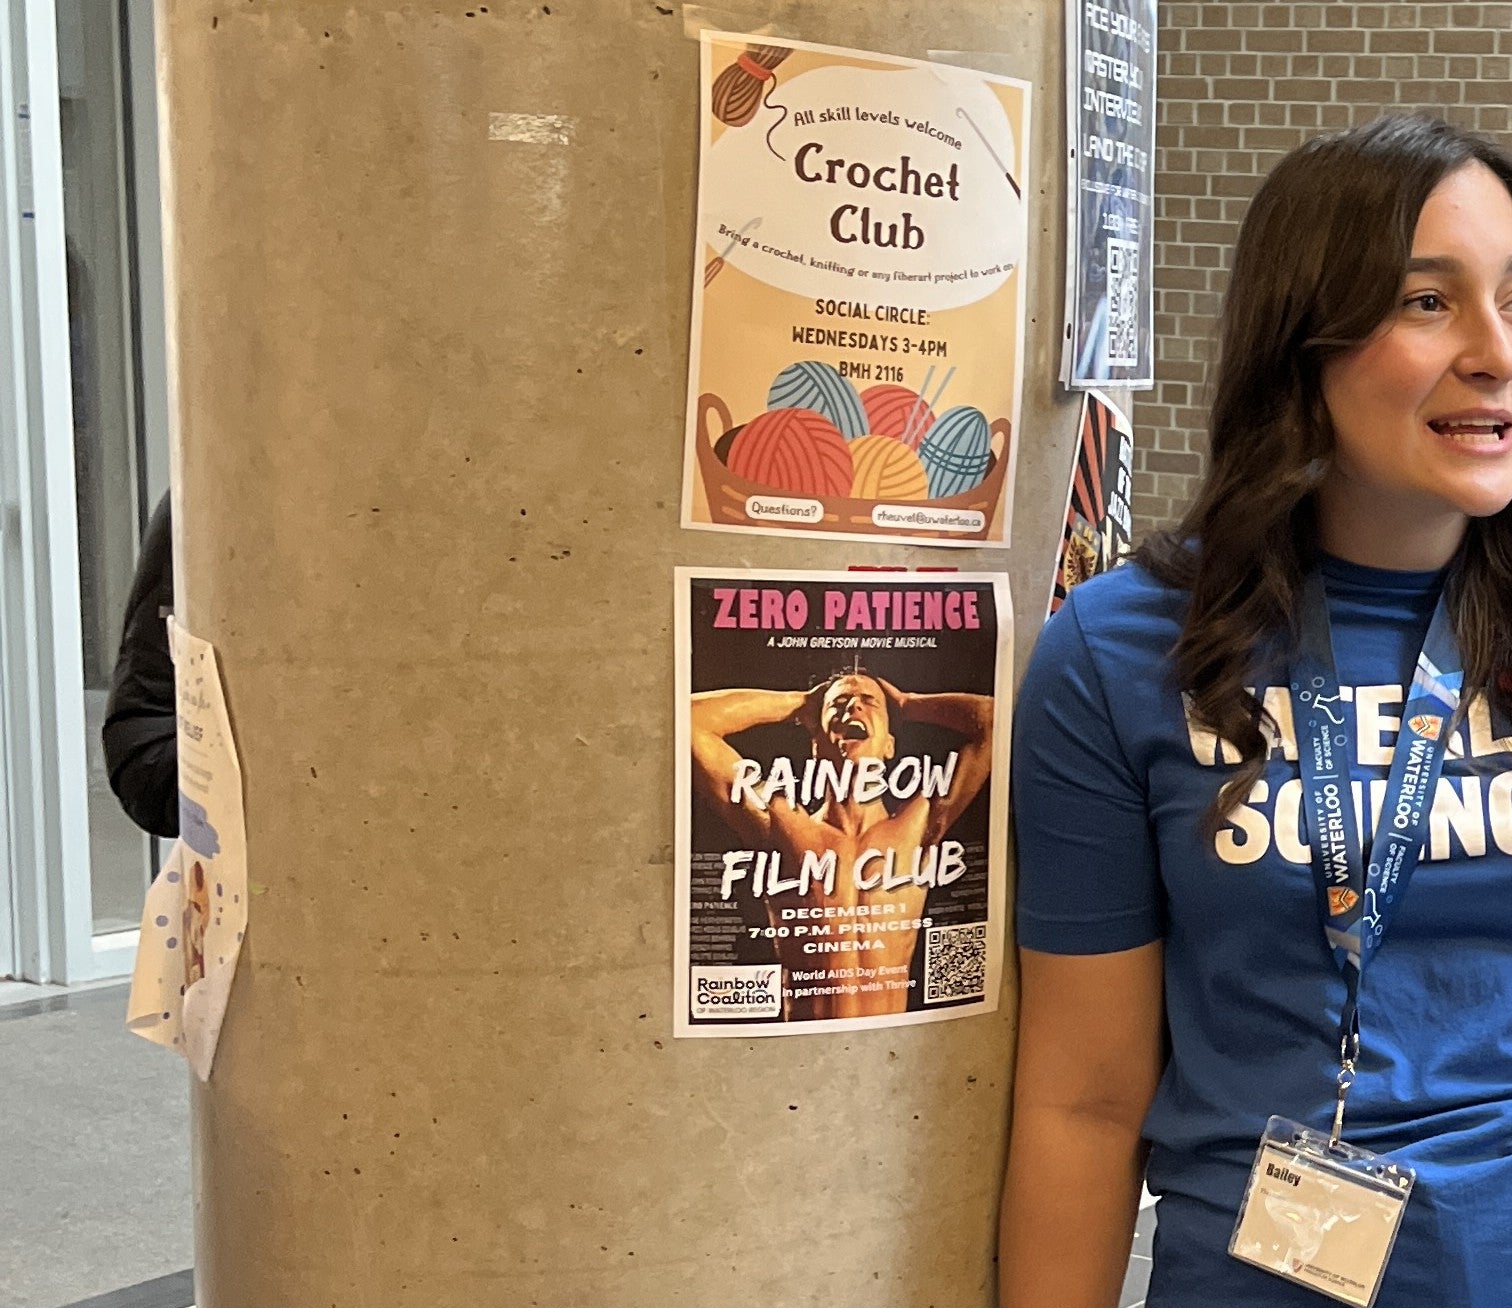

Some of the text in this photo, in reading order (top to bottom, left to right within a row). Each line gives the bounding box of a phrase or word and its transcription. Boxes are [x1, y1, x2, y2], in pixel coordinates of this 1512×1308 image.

[794, 107, 962, 150] All skill levels welcome
[795, 142, 959, 201] Crochet
[830, 204, 924, 250] Club
[718, 224, 751, 246] Bring
[752, 241, 759, 249] a
[810, 257, 855, 277] knitting
[858, 269, 869, 277] or
[872, 271, 890, 282] any
[934, 270, 967, 284] project
[970, 269, 979, 279] to
[981, 265, 1001, 276] work
[1003, 263, 1013, 271] on
[815, 299, 931, 326] SOCIAL CIRCLE:
[792, 326, 947, 357] WEDNESDAYS 3-4PM
[839, 361, 904, 382] BMH 2116
[752, 501, 817, 518] Questions?
[713, 588, 981, 631] ZERO PATIENCE
[767, 637, 937, 648] A JOHN GREYSON MOVIE MUSICAL
[1313, 737, 1324, 771] FACULTY
[1321, 724, 1333, 770] OF SCIENCE
[731, 751, 959, 811] RAINBOW
[1394, 739, 1427, 829] WATERLOO
[1412, 747, 1434, 827] UNIVERSITY OF
[1315, 790, 1333, 879] UNIVERSITY OF
[1324, 783, 1349, 883] WATERLOO
[720, 850, 837, 901] FILM
[853, 840, 967, 890] CLUB
[748, 926, 790, 939] 7:00
[838, 917, 933, 934] PRINCESS
[781, 903, 907, 921] DECEMBER 1
[803, 939, 886, 954] CINEMA
[697, 976, 773, 992] Rainbow
[792, 965, 908, 981] World AIDS Day Event
[795, 984, 859, 999] partnership
[861, 981, 883, 992] with
[885, 979, 917, 990] Thrive
[697, 990, 776, 1005] Coalition
[1266, 1162, 1301, 1187] Bailey
